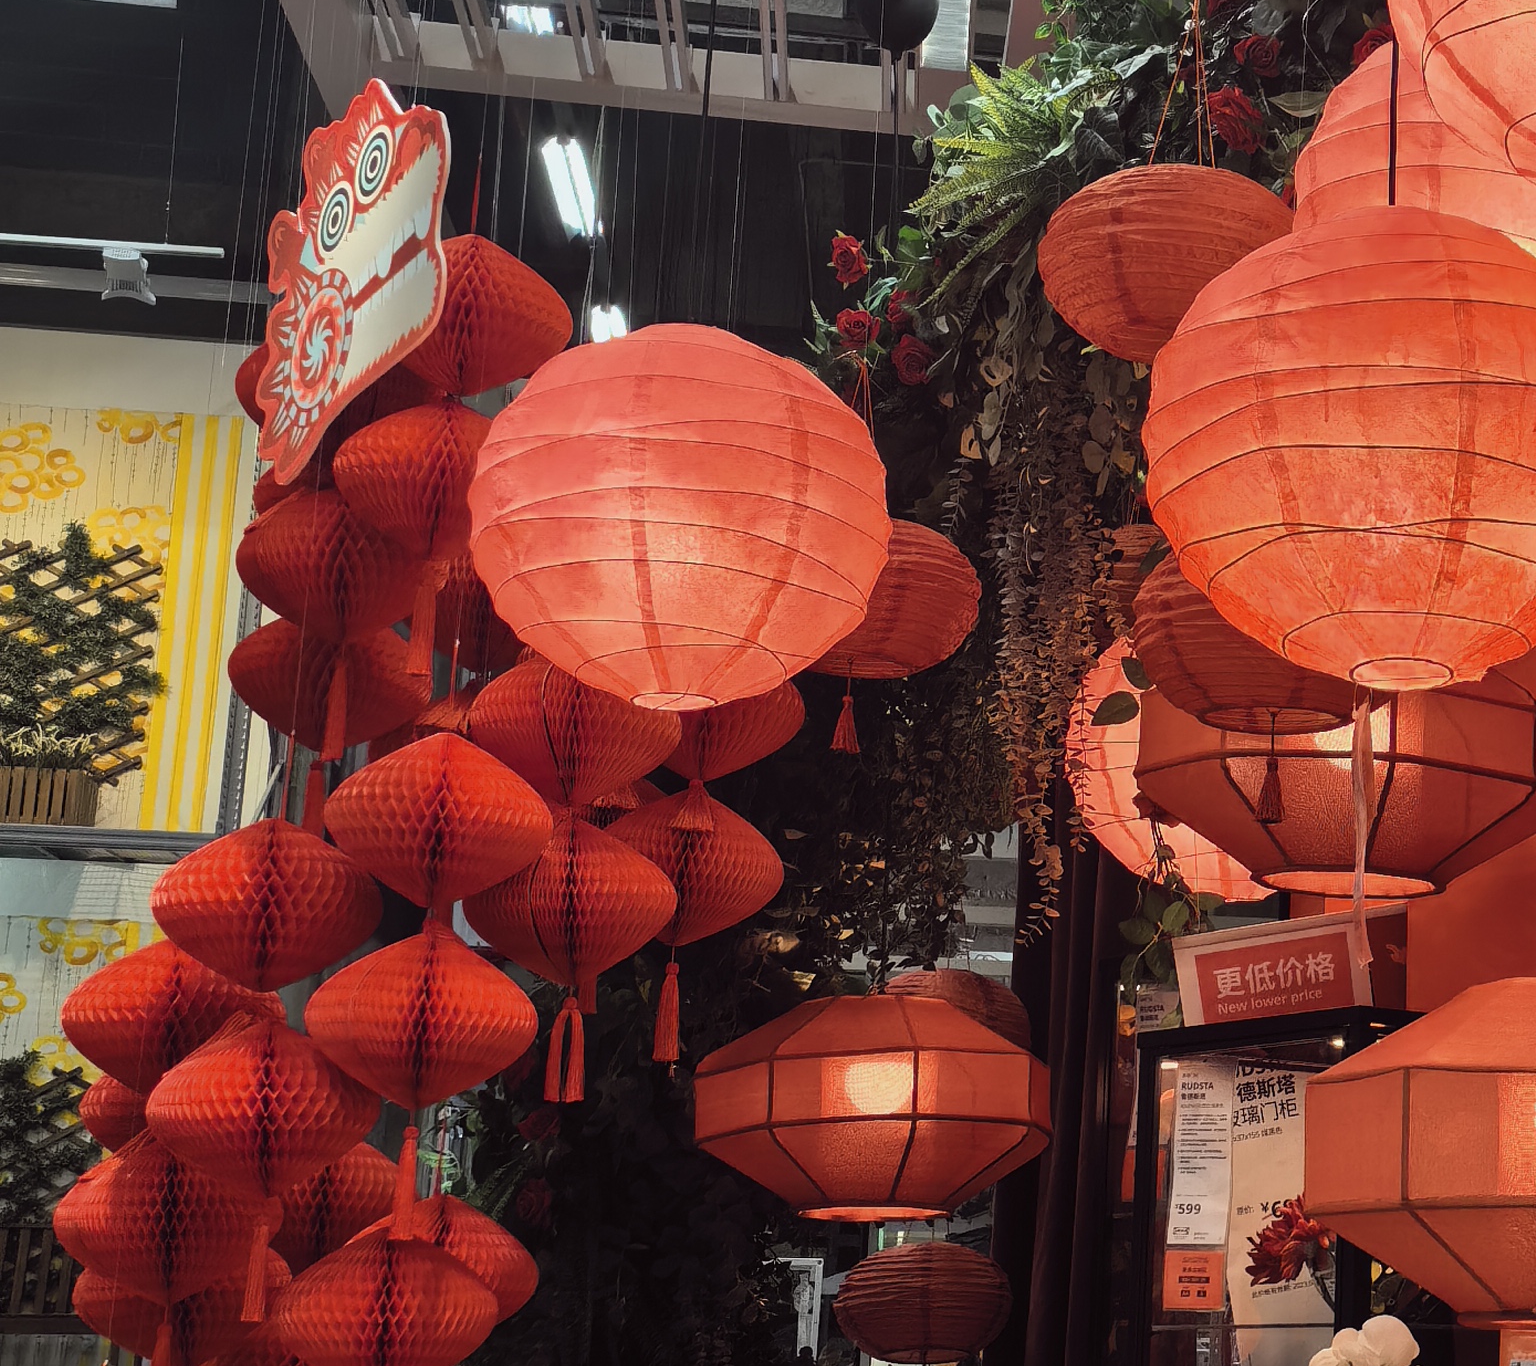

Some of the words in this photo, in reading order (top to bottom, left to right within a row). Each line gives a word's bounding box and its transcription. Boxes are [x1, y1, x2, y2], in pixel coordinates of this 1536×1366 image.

[1213, 952, 1336, 999] 更低价格
[1217, 1001, 1248, 1015] New
[1250, 994, 1288, 1009] lower
[1291, 988, 1323, 1006] price
[1181, 1081, 1214, 1091] RUDSTA
[1236, 1073, 1296, 1104] 德斯塔
[1175, 1203, 1202, 1215] ¥599
